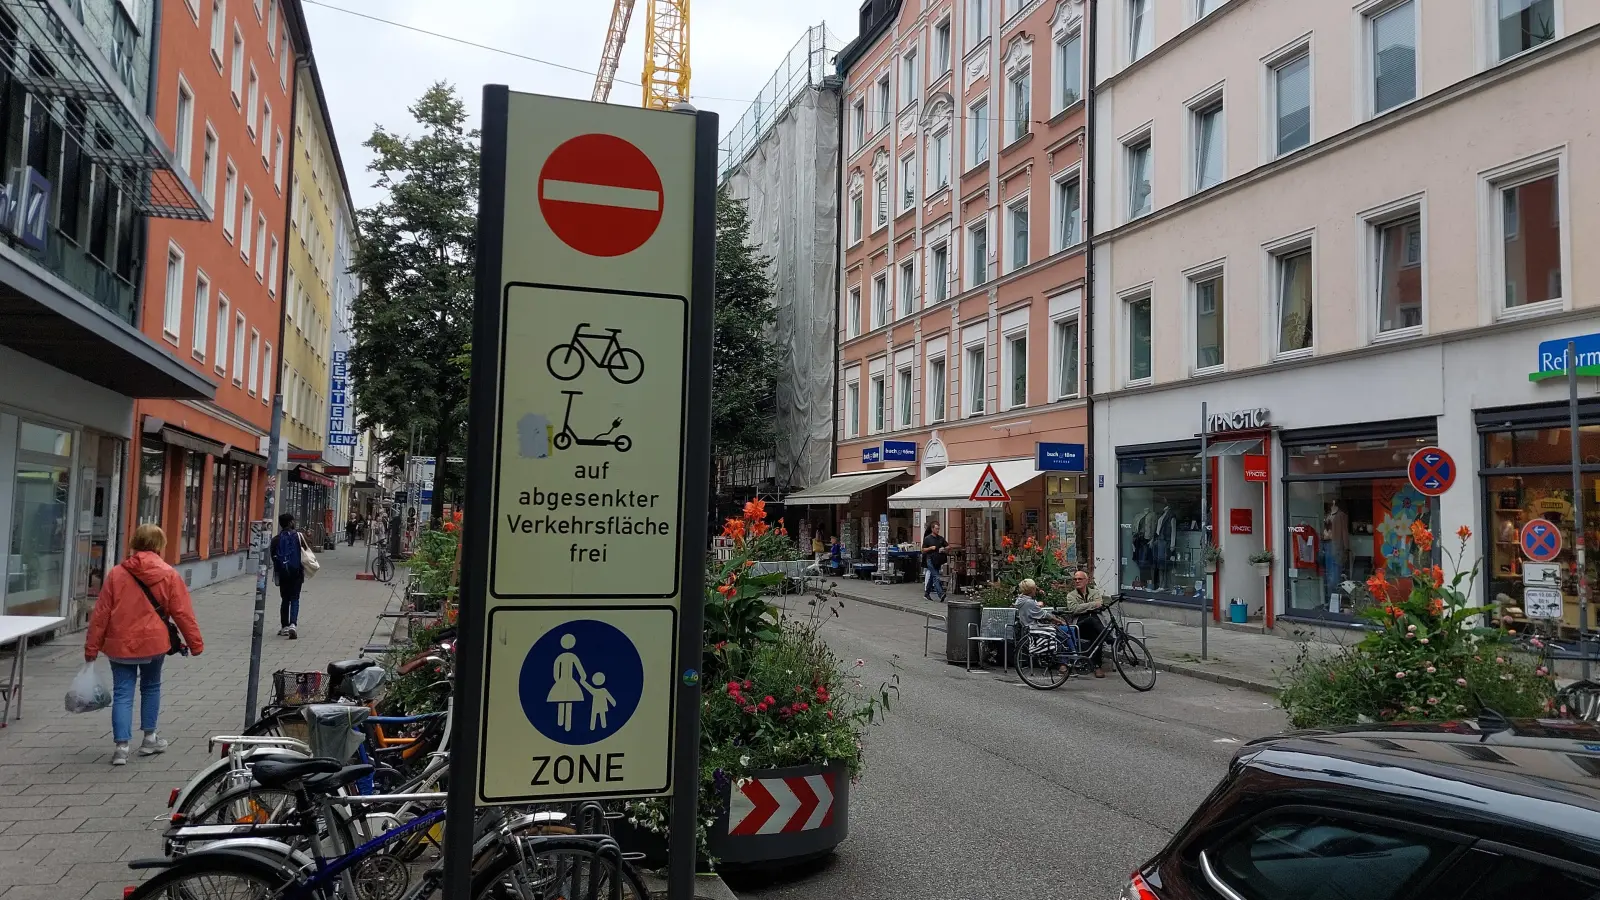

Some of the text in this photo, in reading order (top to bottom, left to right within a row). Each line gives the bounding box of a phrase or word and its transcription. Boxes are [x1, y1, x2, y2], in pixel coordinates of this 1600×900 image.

[332, 352, 346, 431] BETTEN
[1208, 408, 1267, 431] YPNOTIC
[330, 435, 356, 444] LENZ
[574, 462, 610, 480] auf
[518, 488, 660, 511] abgesenkter
[506, 514, 670, 536] Verkehrsfläche
[569, 544, 608, 563] frei
[530, 752, 626, 786] ZONE
